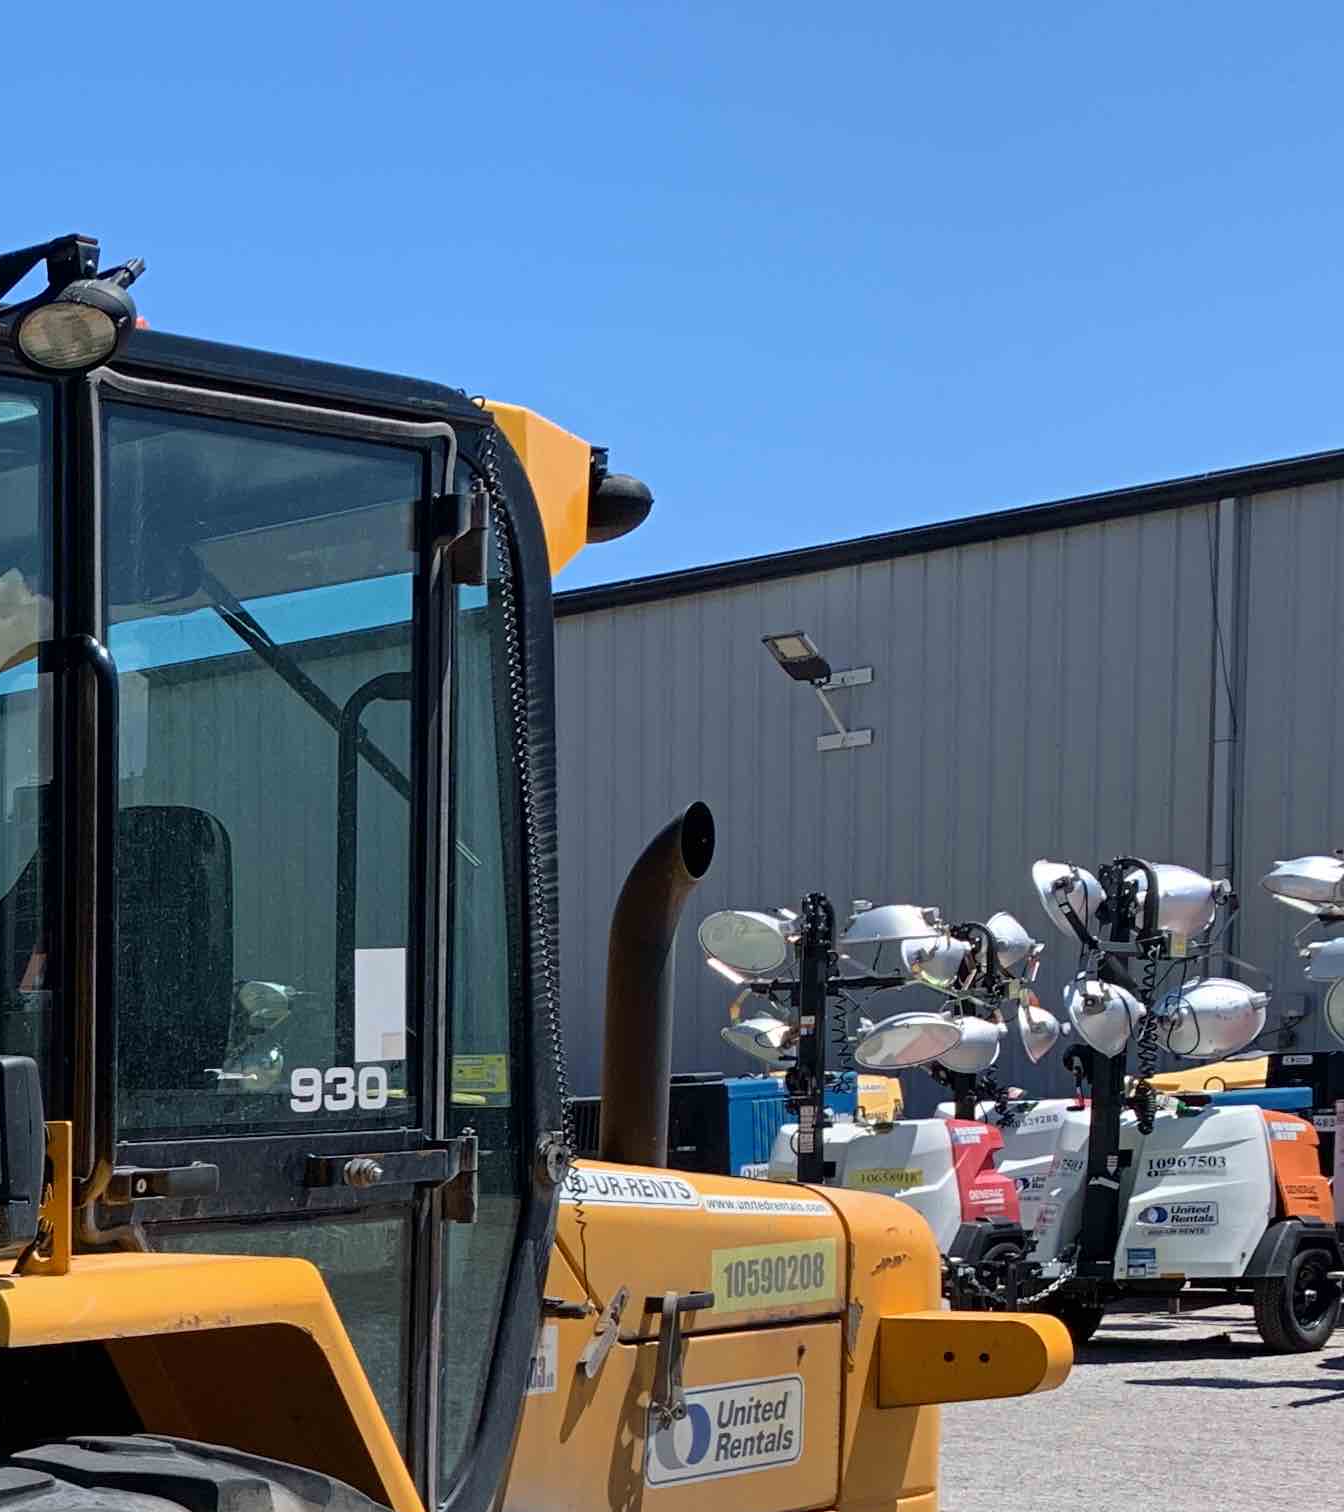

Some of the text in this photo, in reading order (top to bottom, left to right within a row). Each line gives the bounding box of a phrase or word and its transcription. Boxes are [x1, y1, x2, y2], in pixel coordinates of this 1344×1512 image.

[290, 1066, 388, 1112] 930
[1147, 1155, 1226, 1170] 10967503
[705, 1198, 827, 1214] www.unitedrentals.com
[1171, 1204, 1211, 1215] United
[1171, 1213, 1215, 1223] Rentals
[723, 1252, 826, 1299] 10590208
[716, 1391, 790, 1429] United
[714, 1425, 794, 1462] Rentals
